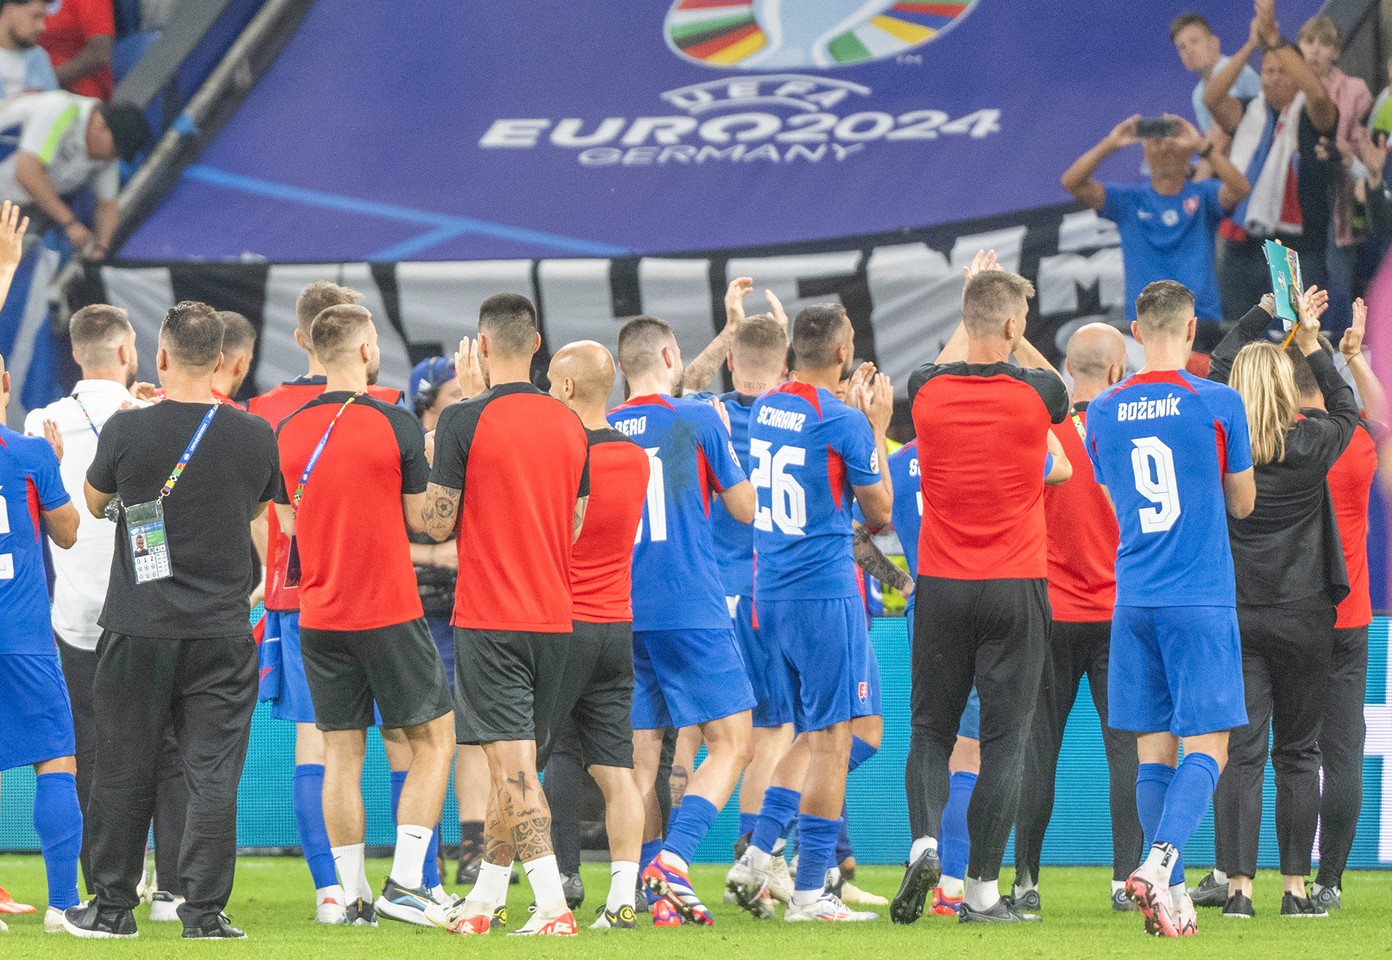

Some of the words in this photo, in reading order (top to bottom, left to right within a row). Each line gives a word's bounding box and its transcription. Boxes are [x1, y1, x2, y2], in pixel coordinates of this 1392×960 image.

[666, 78, 851, 110] UEFA
[479, 108, 1002, 149] EURO2024
[577, 142, 866, 167] GERMANY
[757, 404, 807, 433] SCHRANZ
[1117, 392, 1182, 422] BOŽENÍK
[750, 437, 807, 536] 26
[1130, 436, 1182, 534] 9
